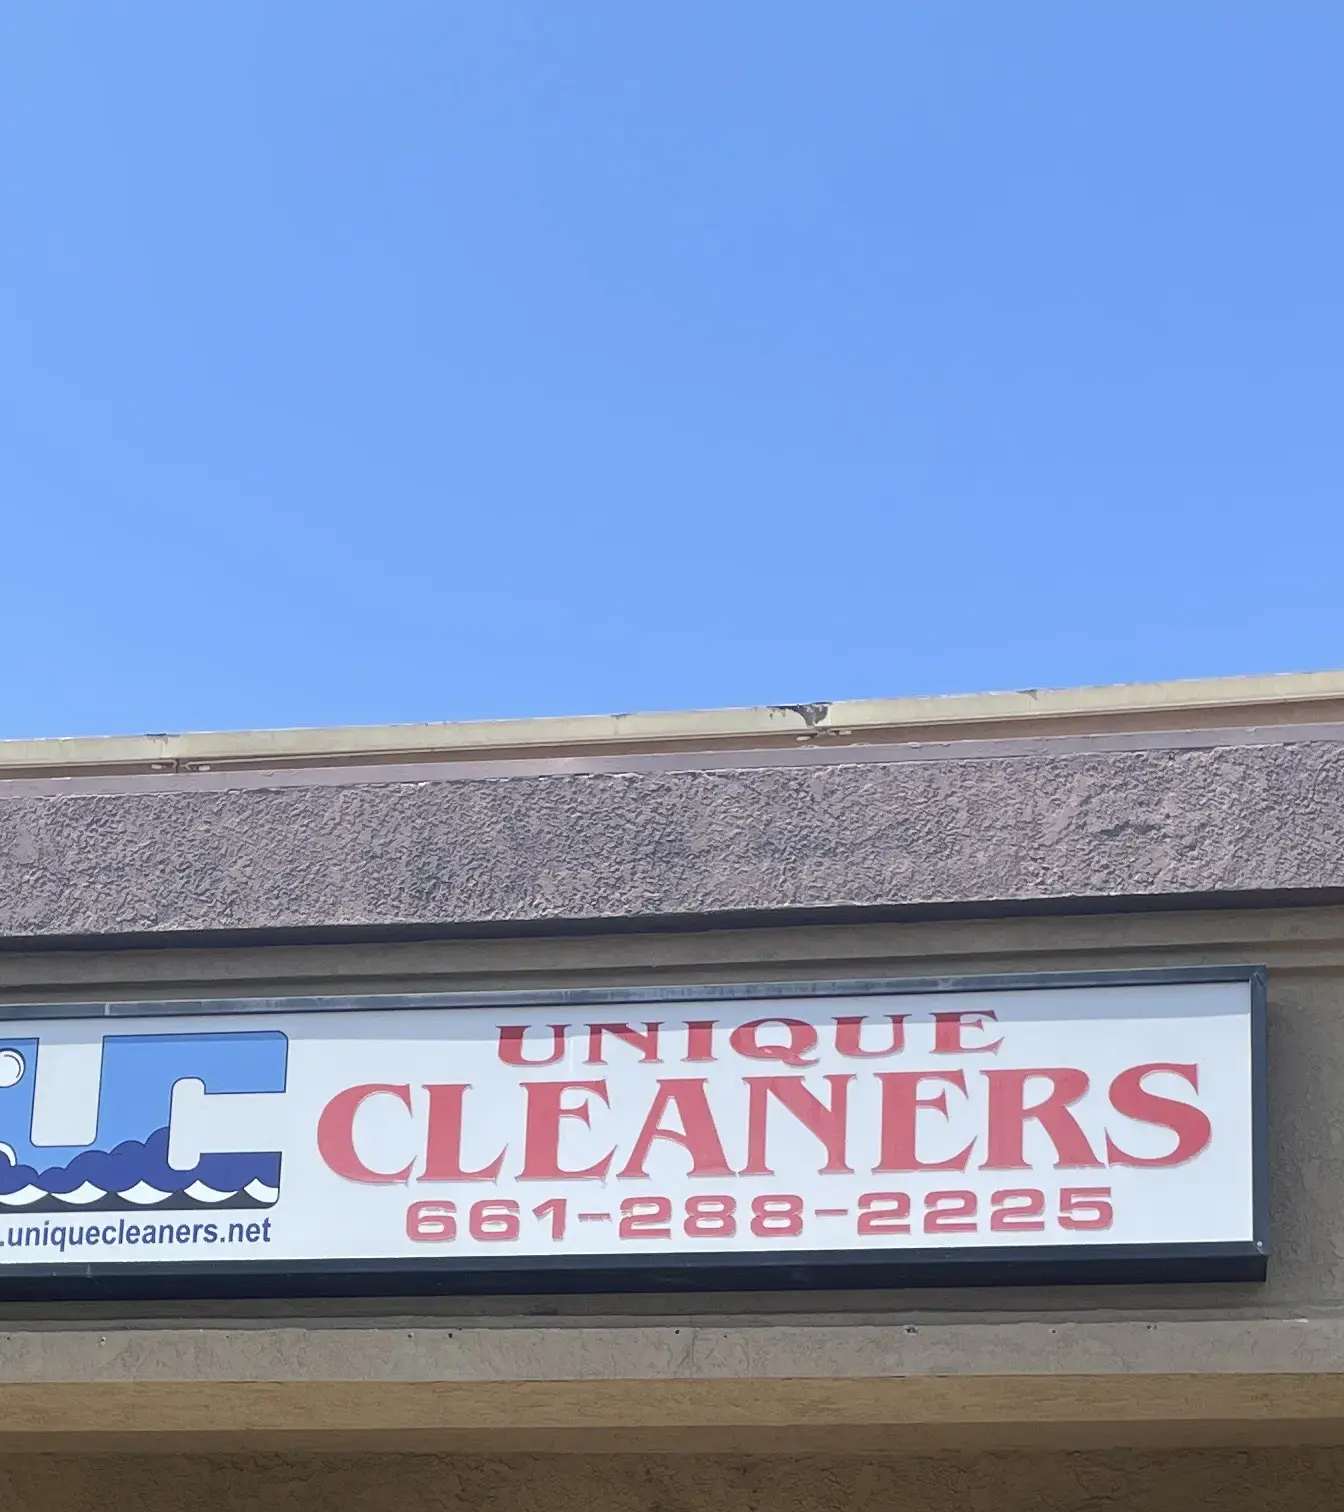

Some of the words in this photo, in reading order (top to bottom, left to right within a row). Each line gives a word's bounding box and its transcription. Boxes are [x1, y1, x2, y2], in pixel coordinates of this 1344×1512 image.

[495, 1009, 1007, 1067] UNIQUE
[316, 1062, 1213, 1187] CLEANERS
[404, 1186, 1114, 1242] 661-288-2225
